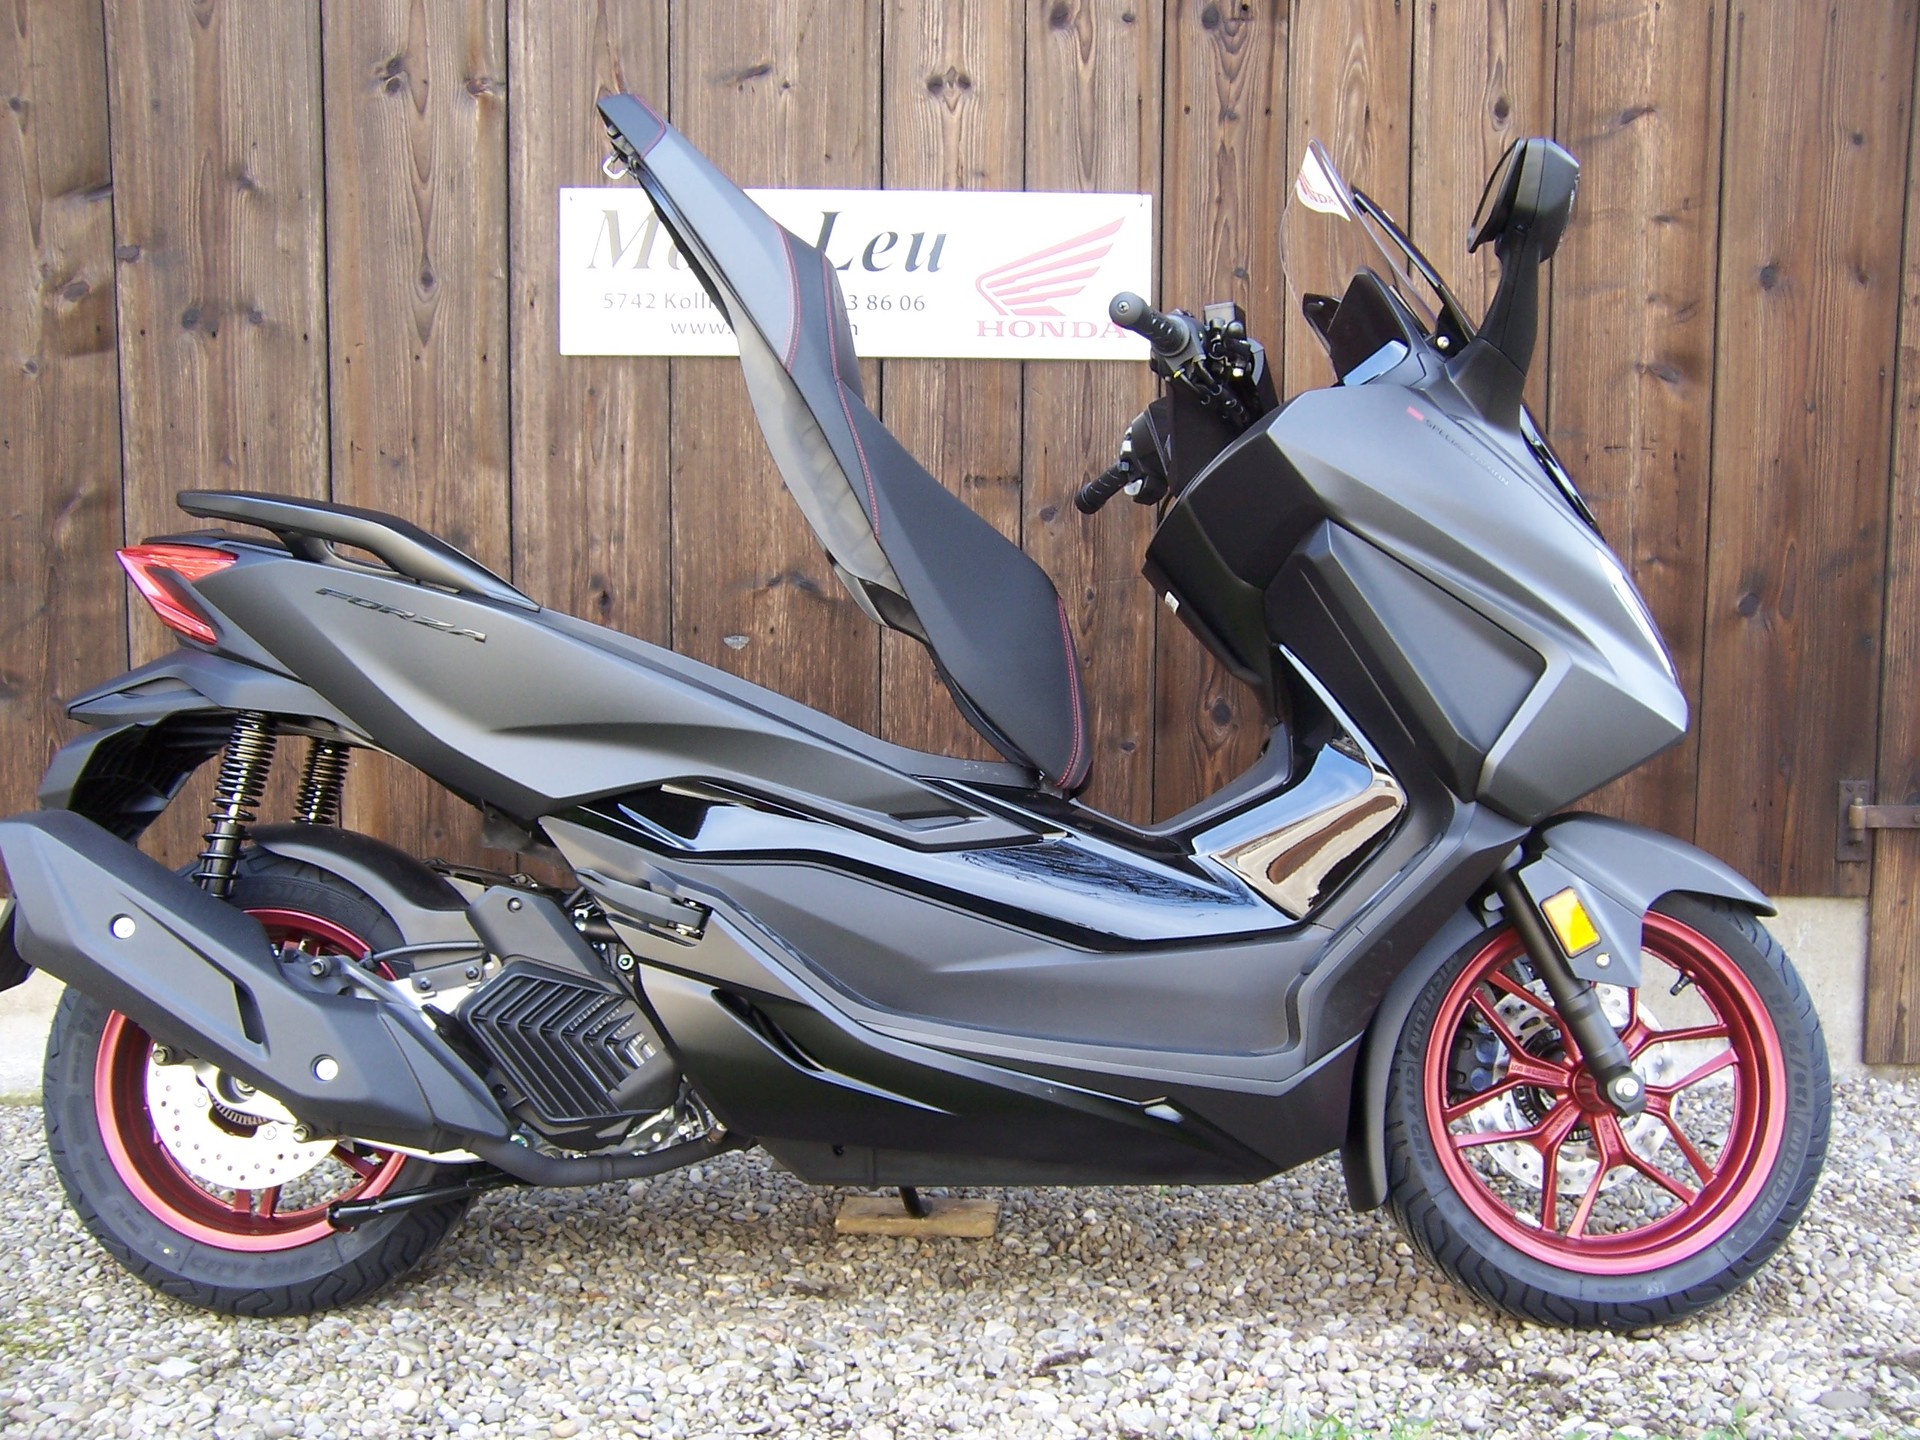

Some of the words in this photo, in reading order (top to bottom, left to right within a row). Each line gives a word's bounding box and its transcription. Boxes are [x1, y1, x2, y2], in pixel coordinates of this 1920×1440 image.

[815, 211, 947, 273] Leu
[603, 293, 656, 309] 5742
[867, 294, 892, 311] 86
[900, 294, 925, 311] 06
[976, 320, 1128, 339] HONDA
[1757, 1127, 1804, 1224] MICHELIN
